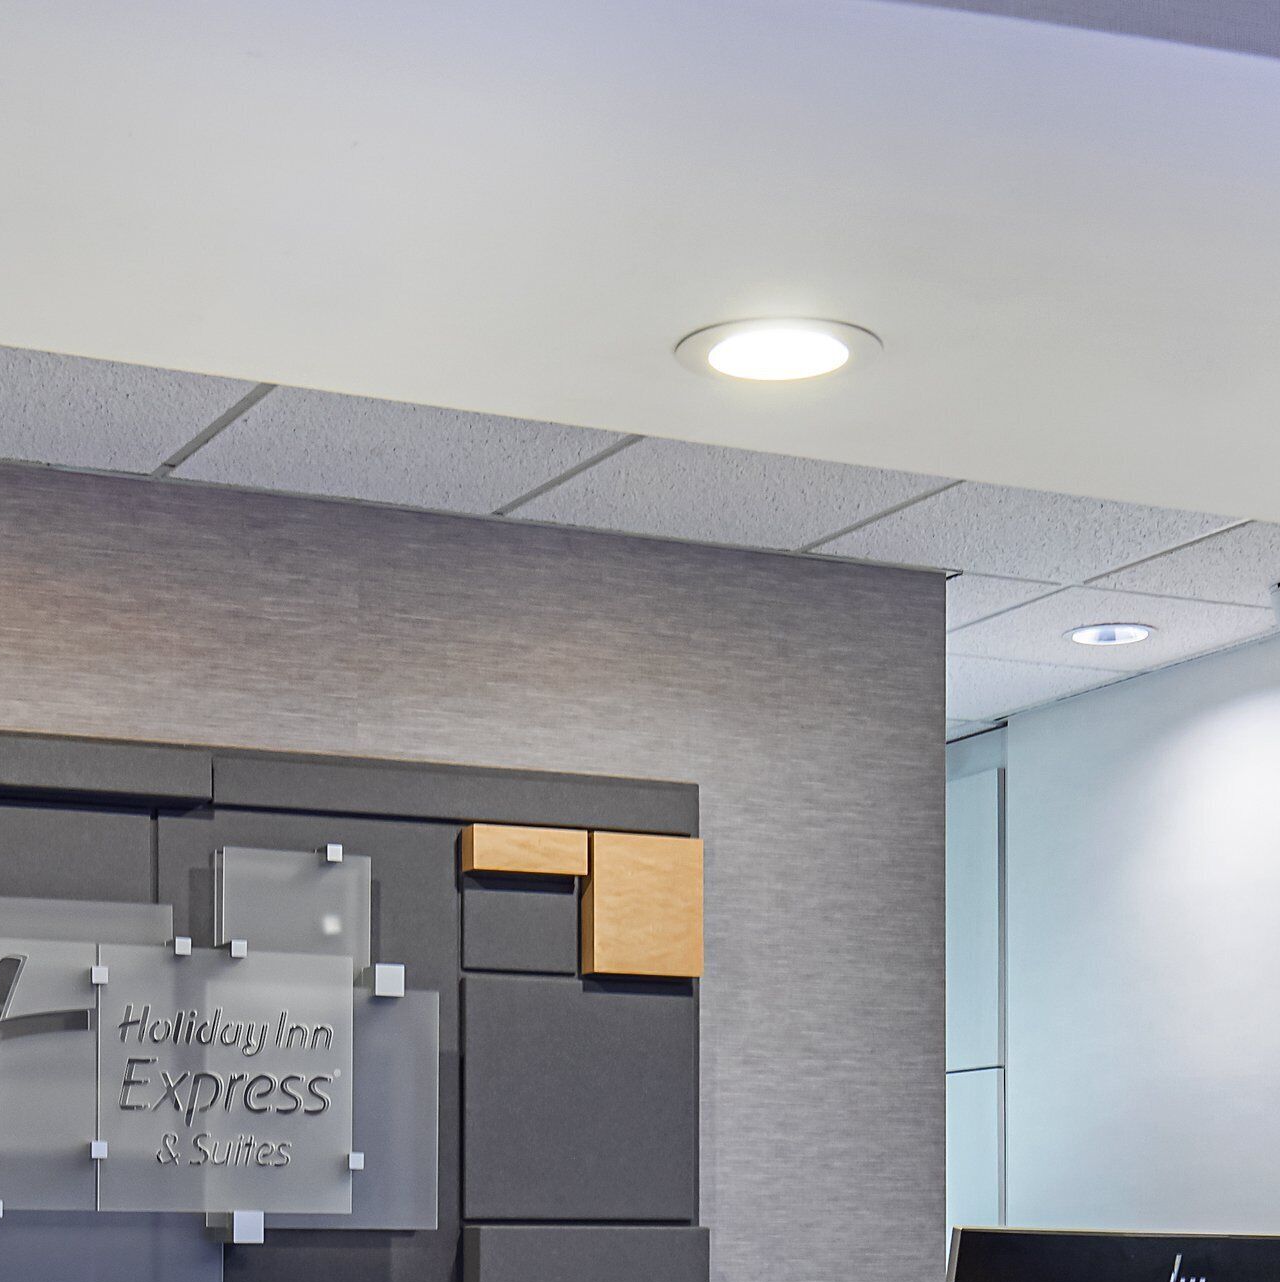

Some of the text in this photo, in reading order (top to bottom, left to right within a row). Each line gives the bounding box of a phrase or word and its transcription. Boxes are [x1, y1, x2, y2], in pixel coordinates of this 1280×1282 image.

[118, 1003, 334, 1057] Holiday Inn
[119, 1057, 333, 1127] Express
[156, 1132, 292, 1167] & Suites
